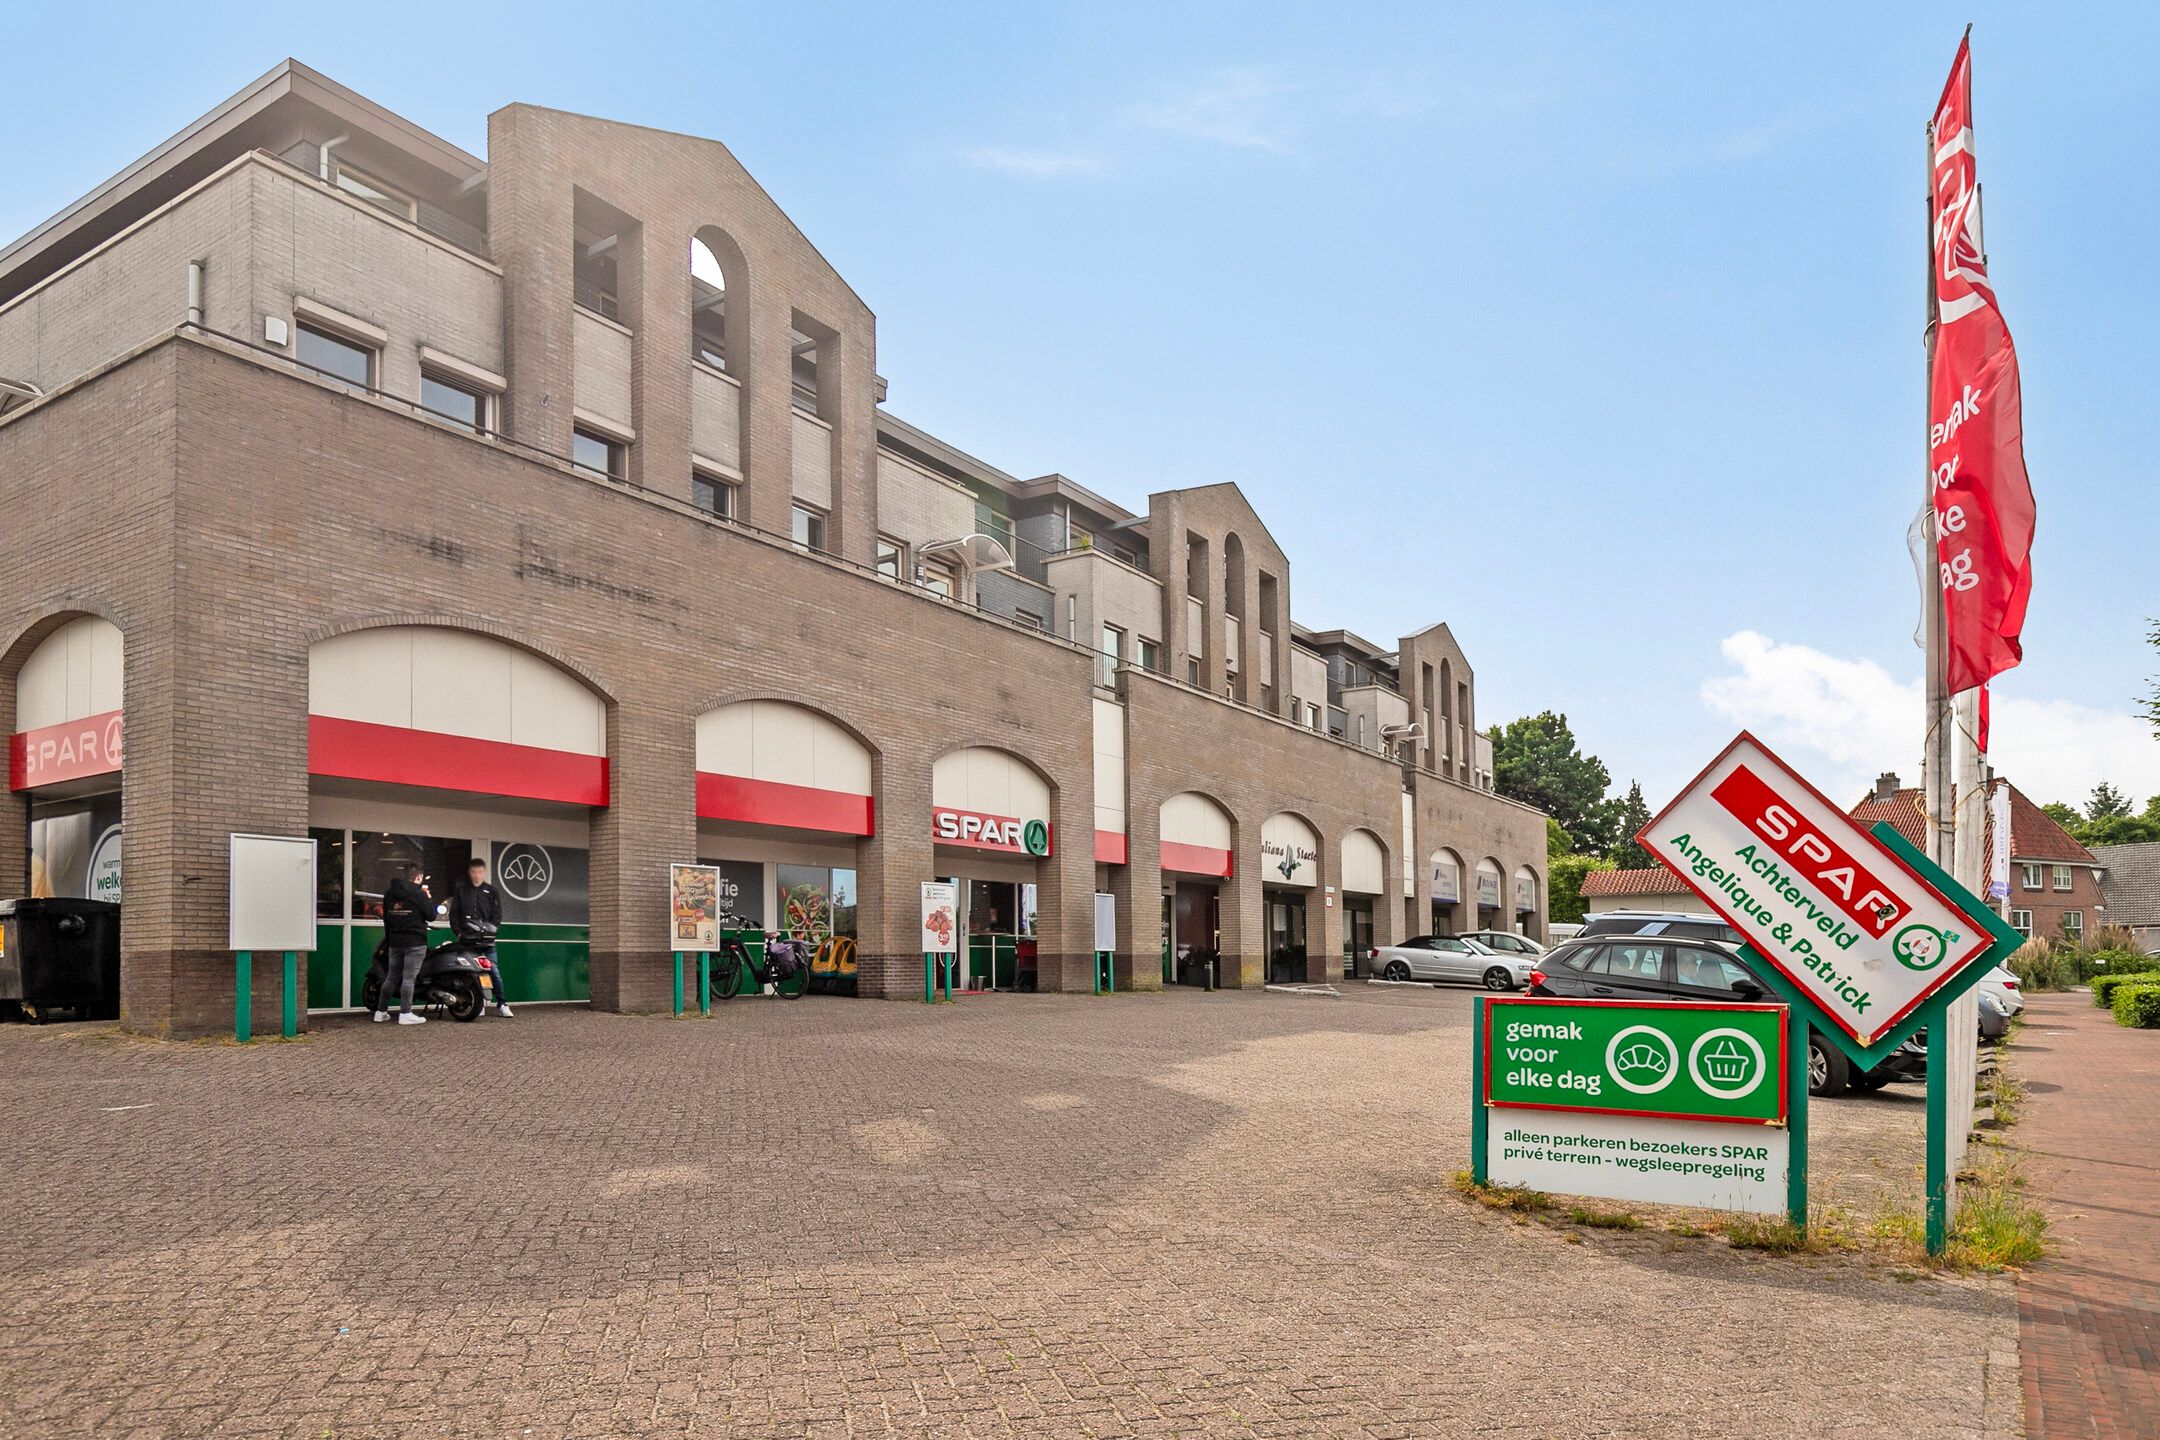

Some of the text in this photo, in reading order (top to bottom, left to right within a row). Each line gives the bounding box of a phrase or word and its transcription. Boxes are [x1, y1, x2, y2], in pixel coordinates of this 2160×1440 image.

[937, 812, 1020, 847] SPAR
[1756, 805, 1899, 930] SPAR
[1735, 844, 1859, 950] Achterveld
[1670, 833, 1872, 1014] Angelique & Patrick
[1506, 1021, 1583, 1042] gemak
[1506, 1047, 1559, 1062] voor
[1506, 1068, 1601, 1096] elke dag
[1504, 1129, 1768, 1161] alleen parkeren bezoekers SPAR
[1504, 1146, 1544, 1161] privé
[1615, 1157, 1766, 1182] wegsleepregeling
